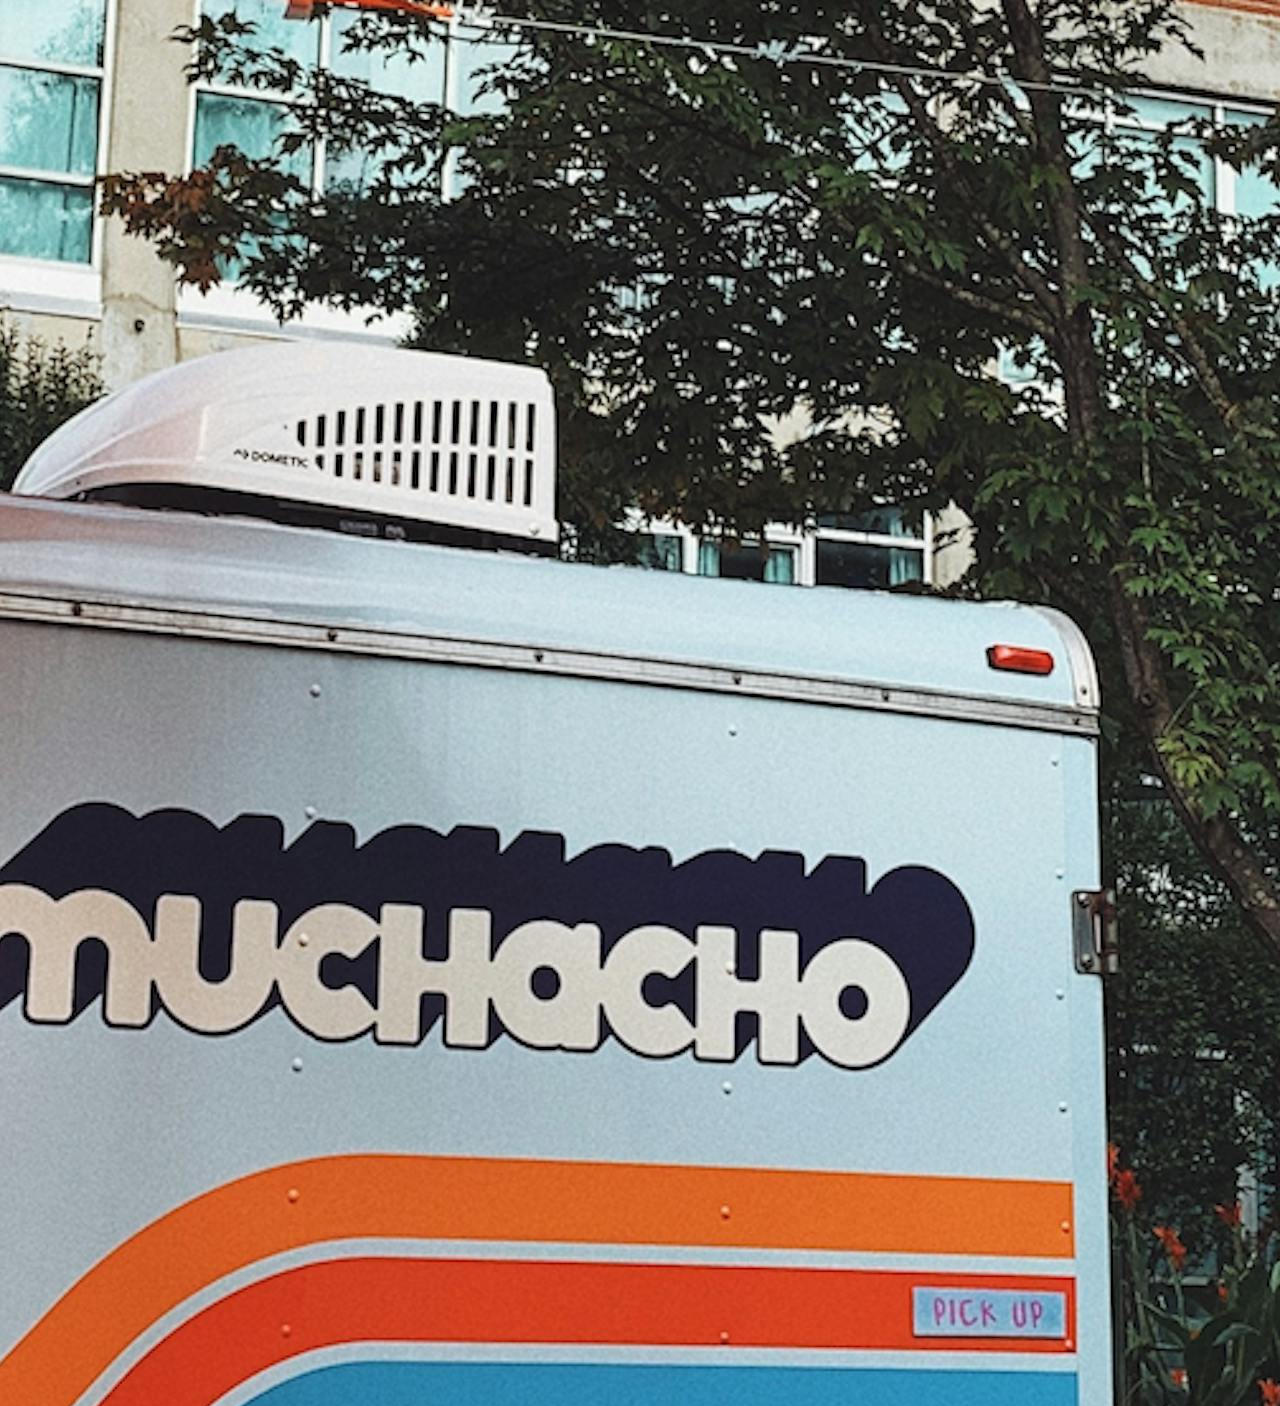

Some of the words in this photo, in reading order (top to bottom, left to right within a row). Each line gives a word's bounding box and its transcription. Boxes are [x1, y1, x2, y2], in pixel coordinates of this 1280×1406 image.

[251, 451, 309, 469] DOMETIC
[933, 1297, 997, 1327] PICK
[1012, 1300, 1043, 1329] UP
